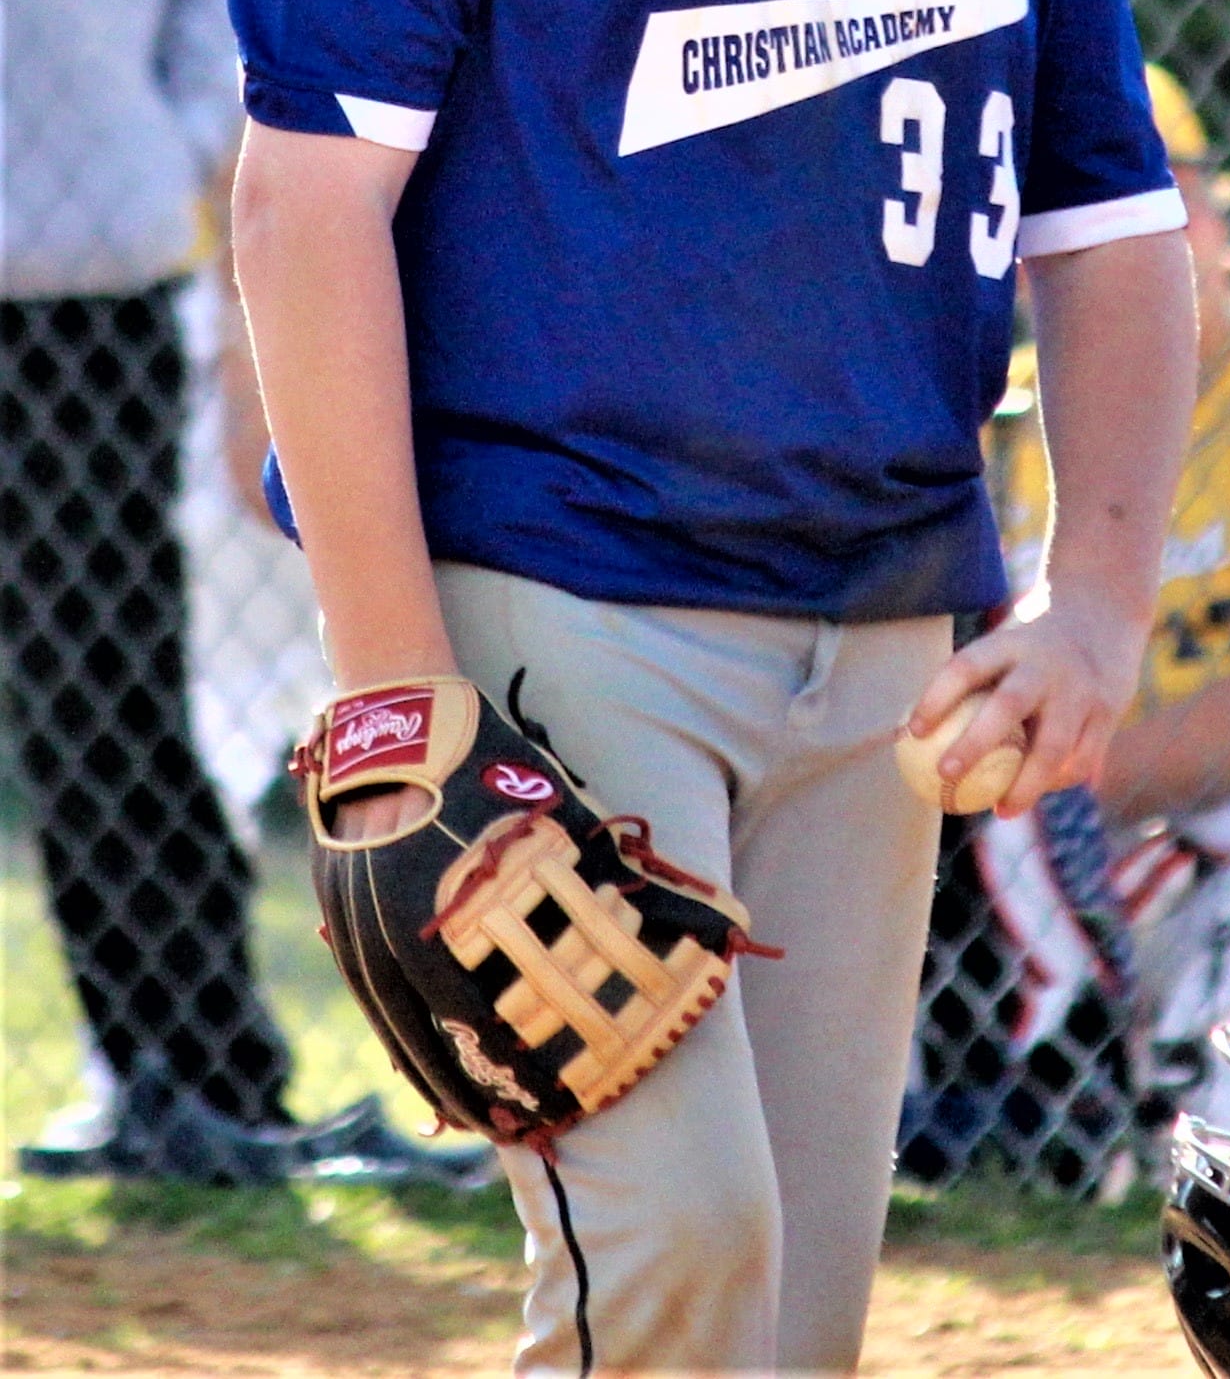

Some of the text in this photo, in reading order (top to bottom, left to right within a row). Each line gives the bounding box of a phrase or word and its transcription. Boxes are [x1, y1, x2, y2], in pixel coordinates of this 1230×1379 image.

[682, 5, 955, 95] CHRISTIAN ACADEMY
[879, 77, 1021, 281] 33
